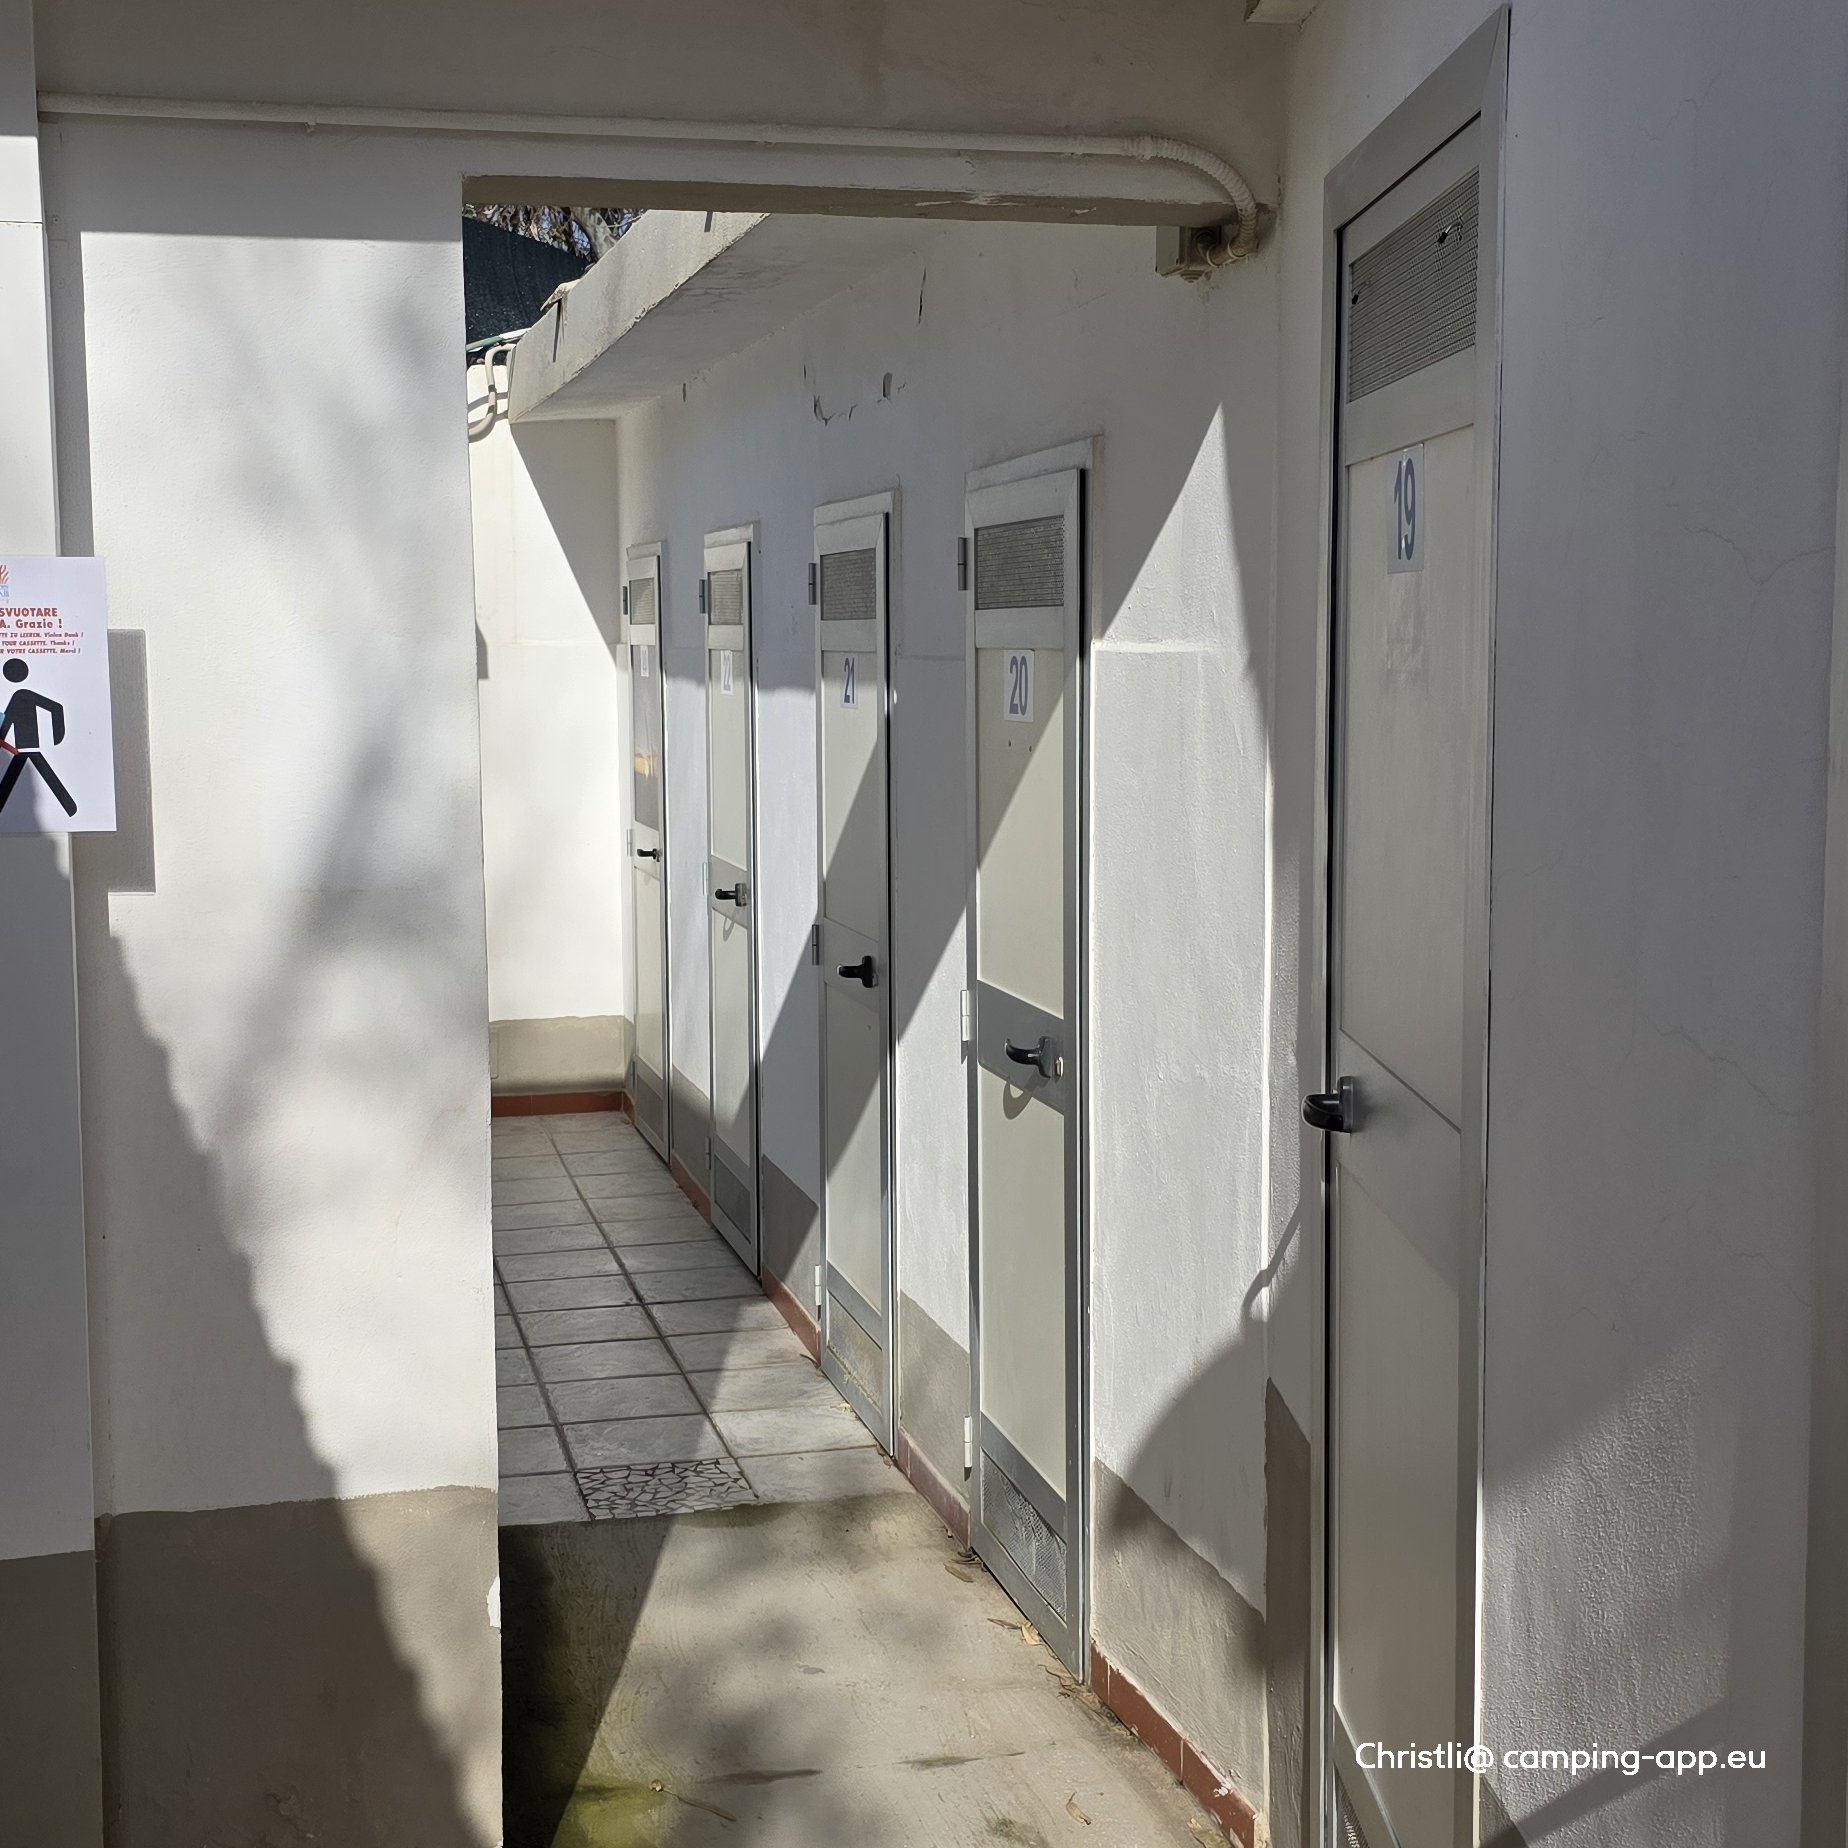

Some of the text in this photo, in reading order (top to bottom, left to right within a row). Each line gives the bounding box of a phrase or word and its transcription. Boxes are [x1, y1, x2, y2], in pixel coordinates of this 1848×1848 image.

[1393, 457, 1416, 560] 19
[16, 619, 53, 628] Grazie
[59, 619, 62, 628] !
[843, 657, 855, 705] 21
[1008, 655, 1029, 717] 20
